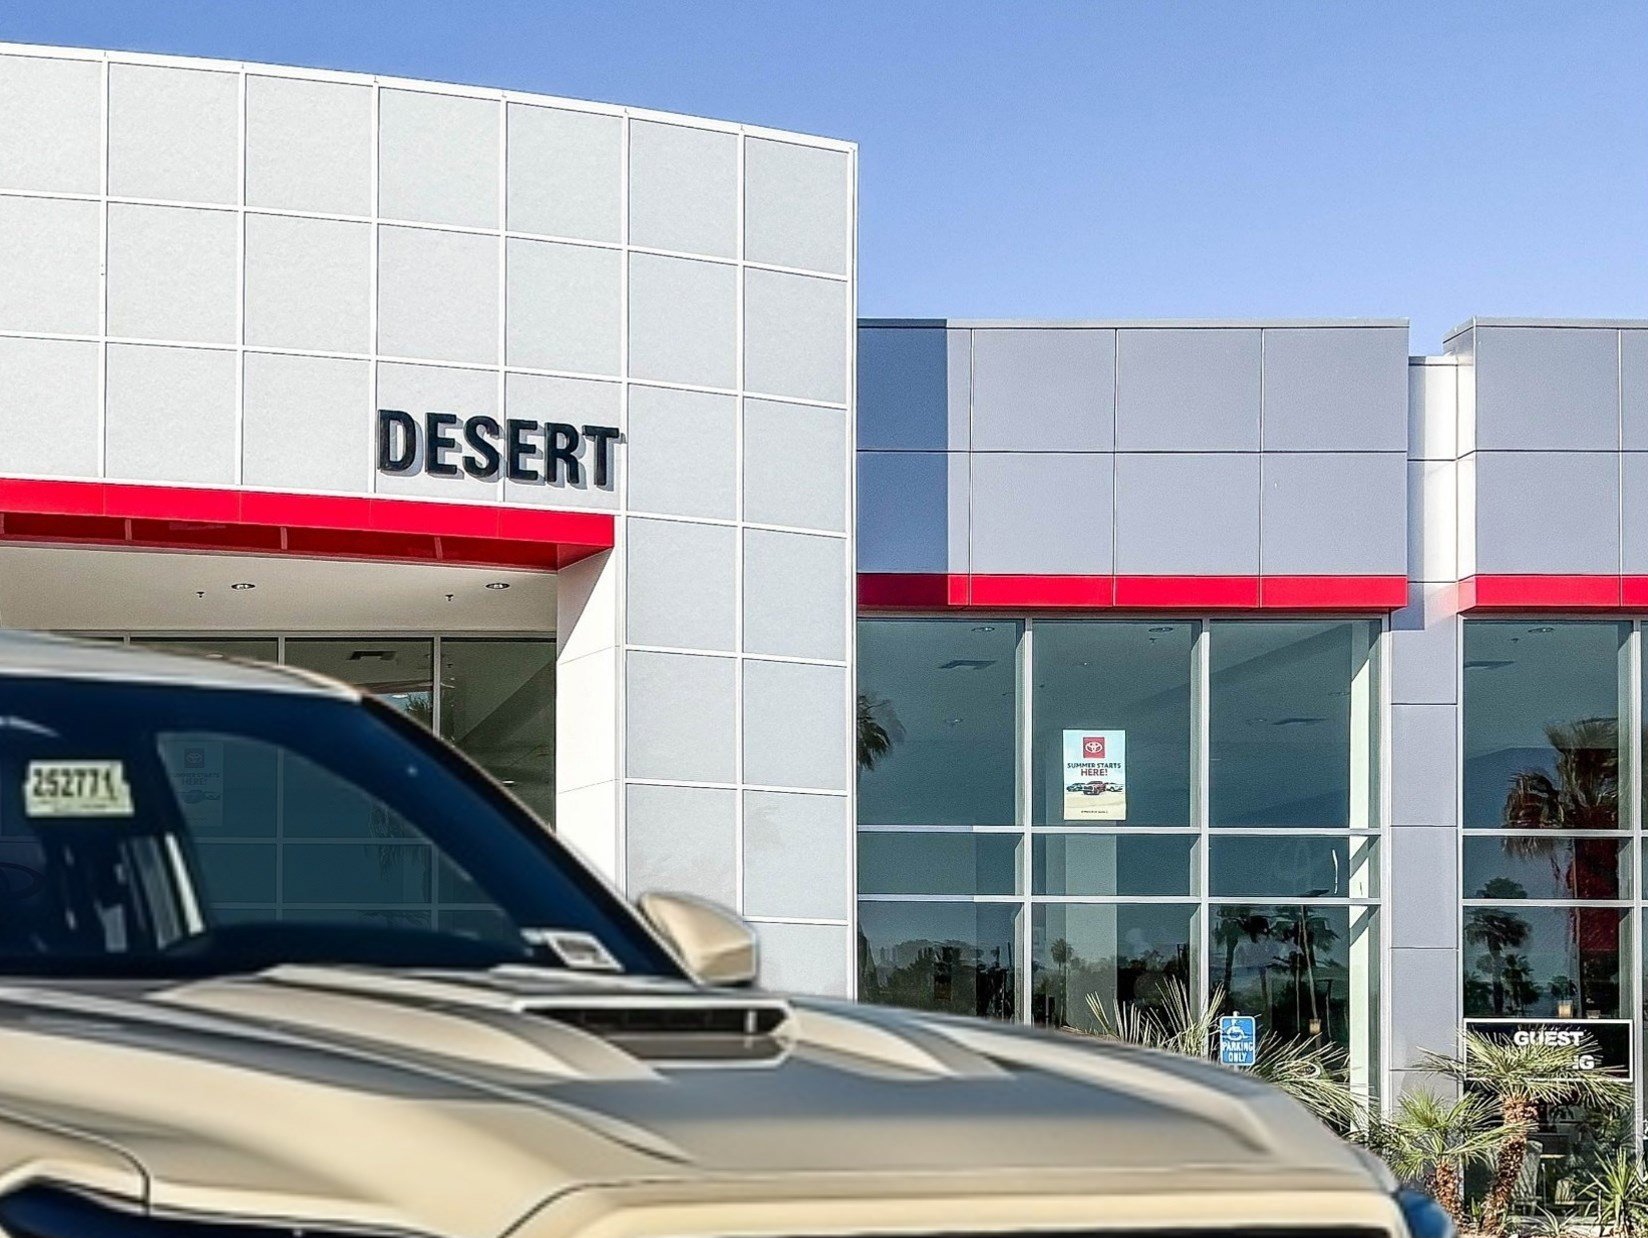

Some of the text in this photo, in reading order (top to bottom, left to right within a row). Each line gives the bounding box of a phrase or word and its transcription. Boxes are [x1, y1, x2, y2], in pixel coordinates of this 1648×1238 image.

[377, 409, 620, 487] DESERT
[1080, 768, 1109, 777] HERE!
[1513, 1031, 1584, 1047] GUEST
[1222, 1041, 1253, 1052] PARKING
[1228, 1052, 1248, 1062] ONLY
